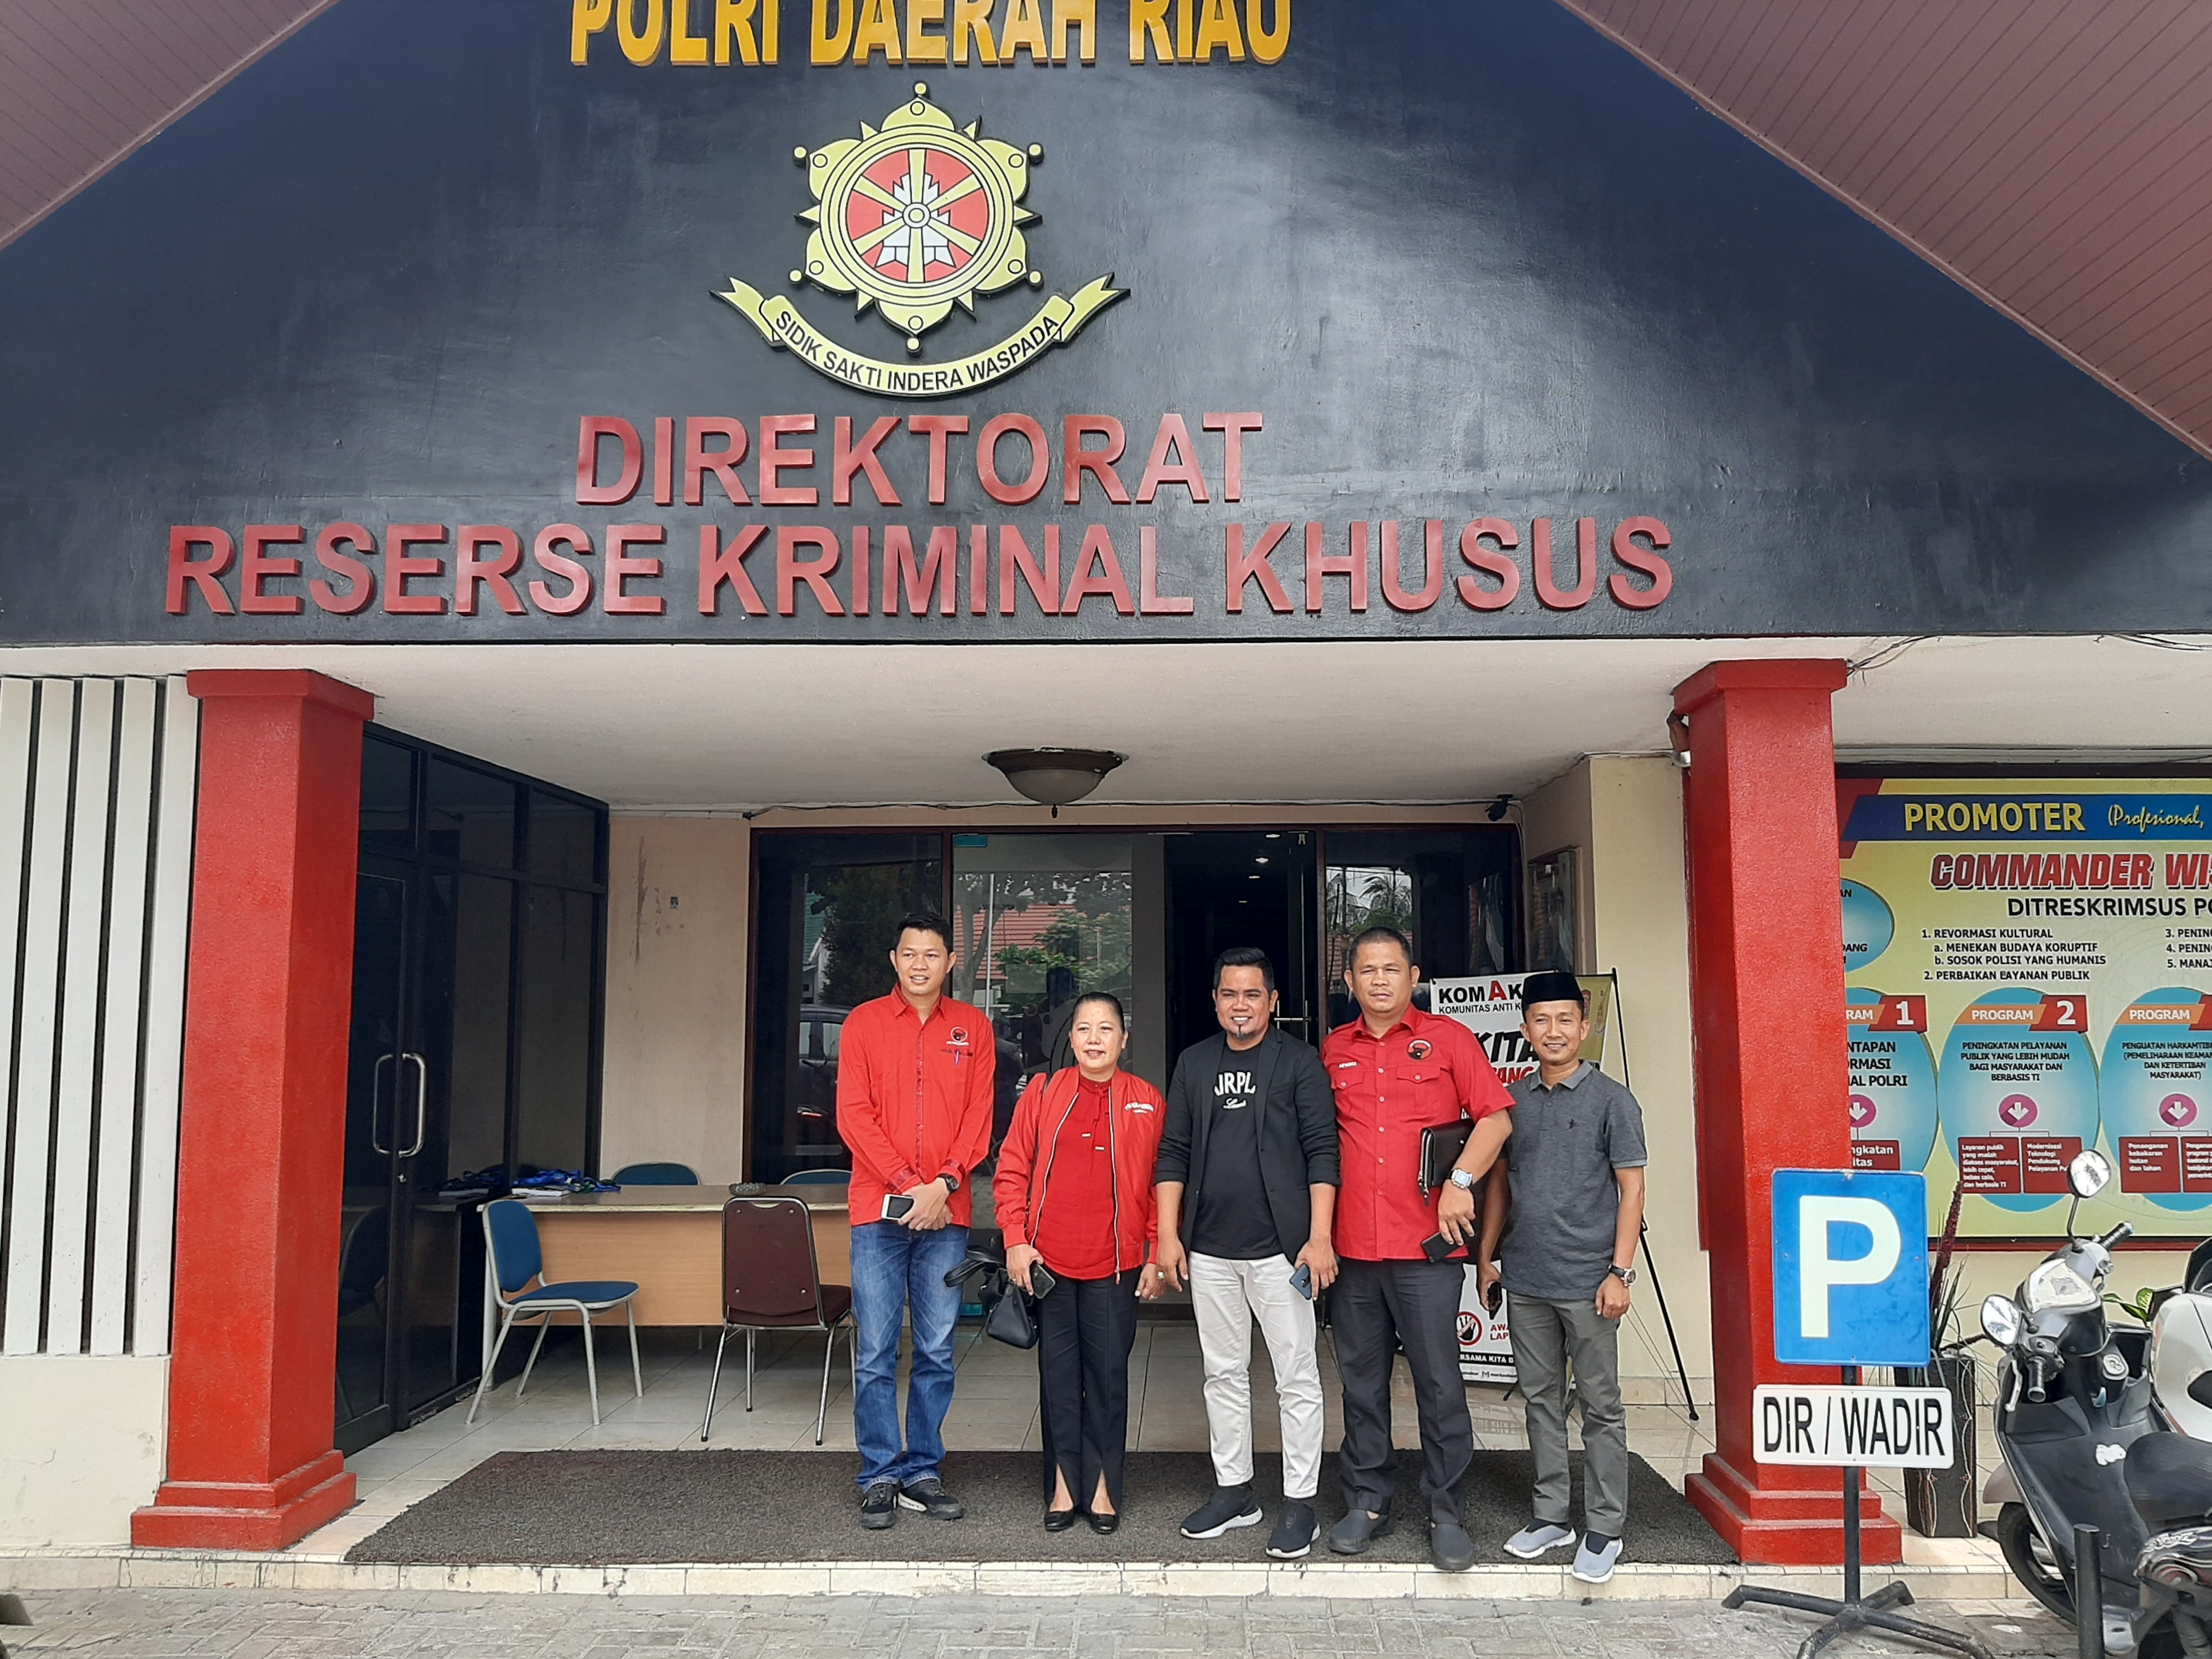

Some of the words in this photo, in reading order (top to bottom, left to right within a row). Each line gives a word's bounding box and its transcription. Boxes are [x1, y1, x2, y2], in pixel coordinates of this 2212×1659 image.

[570, 0, 777, 66] POLRI
[810, 0, 1097, 65] DAERAH
[1128, 0, 1292, 64] RIAU
[776, 310, 819, 361] SIDIK
[823, 351, 882, 388] SAKTI
[887, 370, 963, 392] INDERA
[966, 315, 1059, 383] WASPADA
[575, 412, 1262, 505] DIREKTORAT
[165, 521, 666, 616] RESERSE
[697, 523, 1194, 616] KRIMINAL
[1225, 515, 1673, 614] KHUSUS
[1904, 803, 2086, 831] PROMOTER
[2108, 804, 2205, 833] (Profesional,
[1930, 853, 2154, 890] COMMANDER
[2165, 853, 2212, 890] WI
[2007, 898, 2187, 916] DITRESKRIMSUS
[2194, 898, 2212, 916] P
[1922, 929, 1931, 938] 1.
[1934, 929, 1996, 938] REVORMASI
[2000, 929, 2054, 938] KULTURAL
[2165, 928, 2175, 938] 3.
[1934, 943, 1943, 952] a.
[1946, 943, 1997, 952] MENEKAN
[2000, 943, 2042, 952] BUDAYA
[2046, 943, 2098, 952] KORUPTIF
[2166, 944, 2176, 953] 4.
[2179, 944, 2212, 953] PENIN
[1935, 956, 1944, 964] b.
[1947, 956, 1983, 964] SOSOK
[1986, 956, 2022, 964] POLISI
[2025, 956, 2053, 964] YANG
[2057, 956, 2106, 964] HUMANIS
[2167, 959, 2177, 968] 5.
[1924, 971, 1933, 980] 2.
[1937, 971, 1996, 979] PERBAIKAN
[2000, 971, 2048, 980] LAYANAN
[2052, 971, 2090, 979] PUBLIK
[1439, 1004, 1490, 1014] KOMUNITAS
[1493, 1003, 1512, 1012] ANTI
[1896, 1000, 1914, 1025] 1
[1971, 1009, 2033, 1020] PROGRAM
[2057, 1000, 2076, 1025] 2
[2129, 1009, 2190, 1020] PROGRAM
[1848, 1058, 1891, 1070] RMASI
[1869, 1075, 1908, 1086] POLRI
[2150, 1071, 2201, 1079] MASYARAKAT)
[1214, 1071, 1256, 1095] JRPL
[1799, 1195, 1901, 1338] P
[1763, 1395, 1815, 1455] DIR
[1840, 1397, 1946, 1457] WADIR
